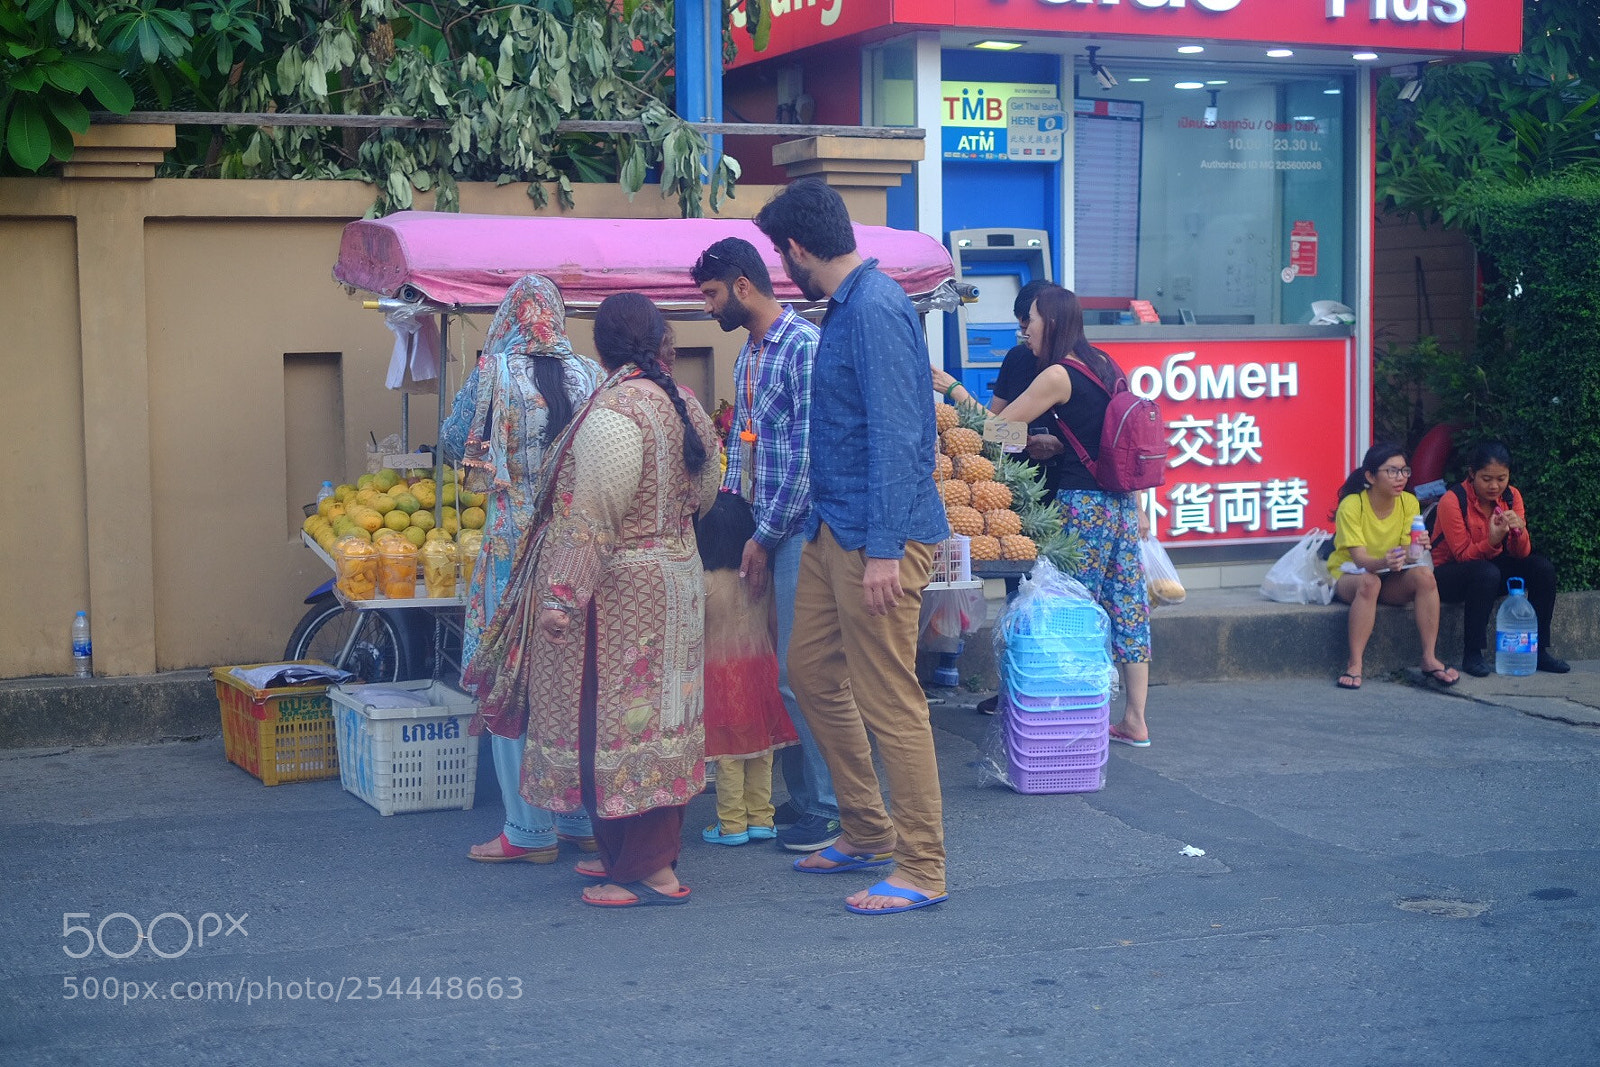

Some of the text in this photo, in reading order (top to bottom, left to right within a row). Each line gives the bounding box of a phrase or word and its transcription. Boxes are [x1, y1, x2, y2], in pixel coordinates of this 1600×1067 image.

[943, 88, 1003, 121] TMB
[1011, 116, 1036, 126] HERE
[1265, 120, 1292, 132] Open
[1295, 121, 1319, 134] Daily
[957, 131, 995, 151] ATM
[1274, 138, 1307, 152] 23.30
[1200, 160, 1247, 170] Authorized
[1130, 352, 1298, 401] обмен
[1169, 412, 1262, 467] 交换
